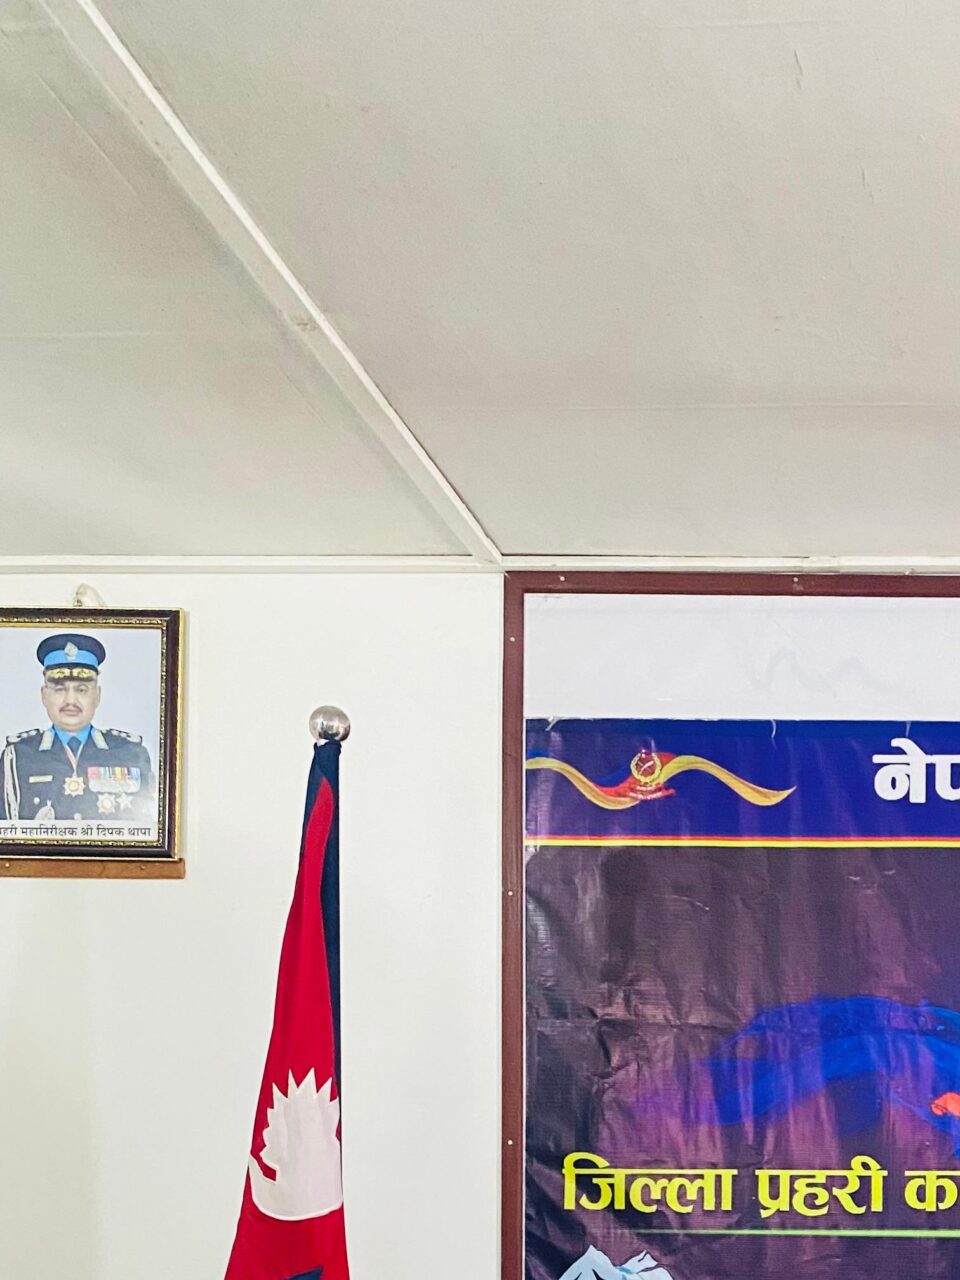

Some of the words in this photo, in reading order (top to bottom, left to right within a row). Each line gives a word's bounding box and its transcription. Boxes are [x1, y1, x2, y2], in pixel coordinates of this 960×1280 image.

[20, 823, 78, 836] महानिरीक्षक
[81, 824, 93, 836] श्री
[97, 823, 125, 836] दिपक
[128, 826, 151, 836] थापा
[562, 1151, 738, 1213] जिल्ला
[755, 1155, 888, 1217] प्रहरी
